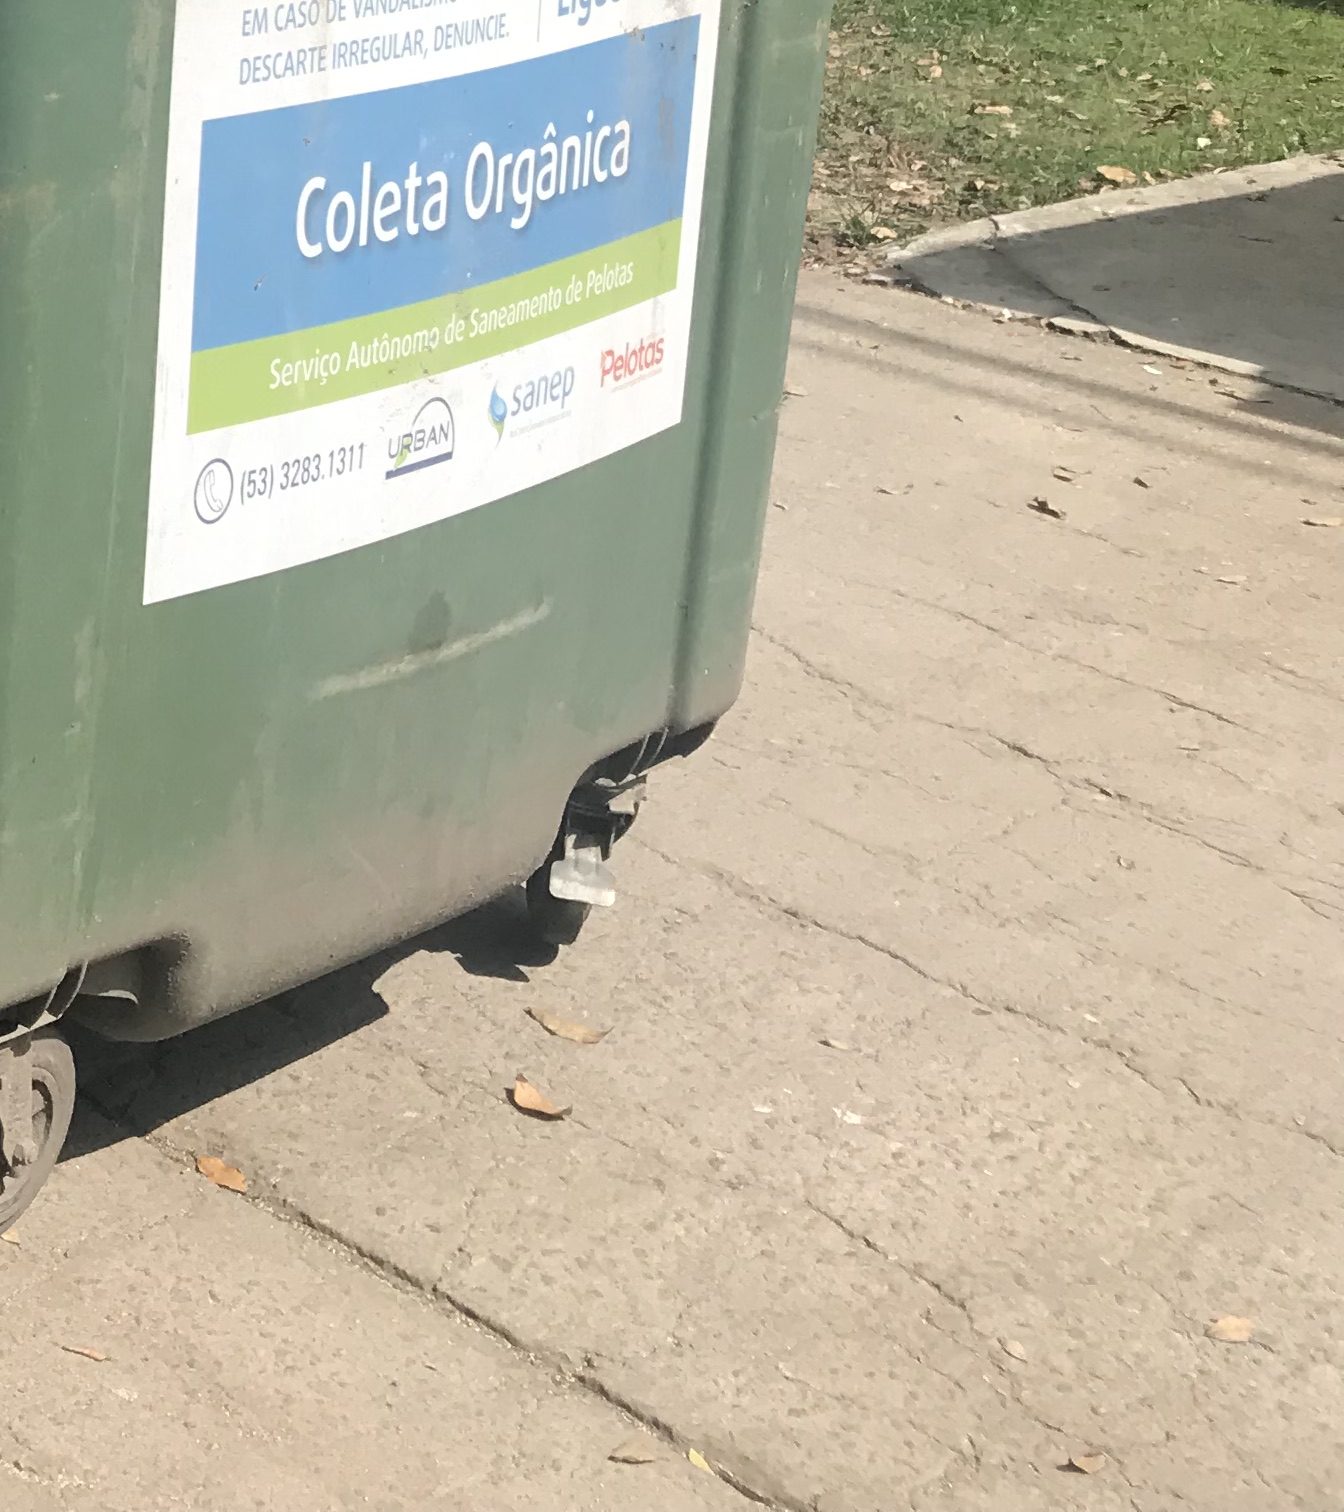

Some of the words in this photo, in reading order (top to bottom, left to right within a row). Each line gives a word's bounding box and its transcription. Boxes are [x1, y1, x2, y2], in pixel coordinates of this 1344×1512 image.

[241, 6, 269, 37] EM
[273, 0, 320, 32] CASO
[239, 44, 327, 86] DESCARTE
[331, 28, 429, 70] IRREGULAR,
[433, 13, 510, 52] DENUNCIE.
[296, 161, 449, 259] Coleta
[465, 109, 632, 230] Orgânica
[269, 349, 342, 390] Serviço
[346, 326, 440, 372] Autônomo
[444, 318, 465, 346] de
[469, 285, 562, 338] Saneamento
[565, 274, 583, 306] de
[585, 261, 634, 299] Pelotas
[511, 366, 575, 417] sanep
[600, 337, 665, 388] Pelotas
[388, 420, 450, 459] URBAN
[240, 463, 274, 506] (53)
[279, 441, 365, 491] 3283.1311
